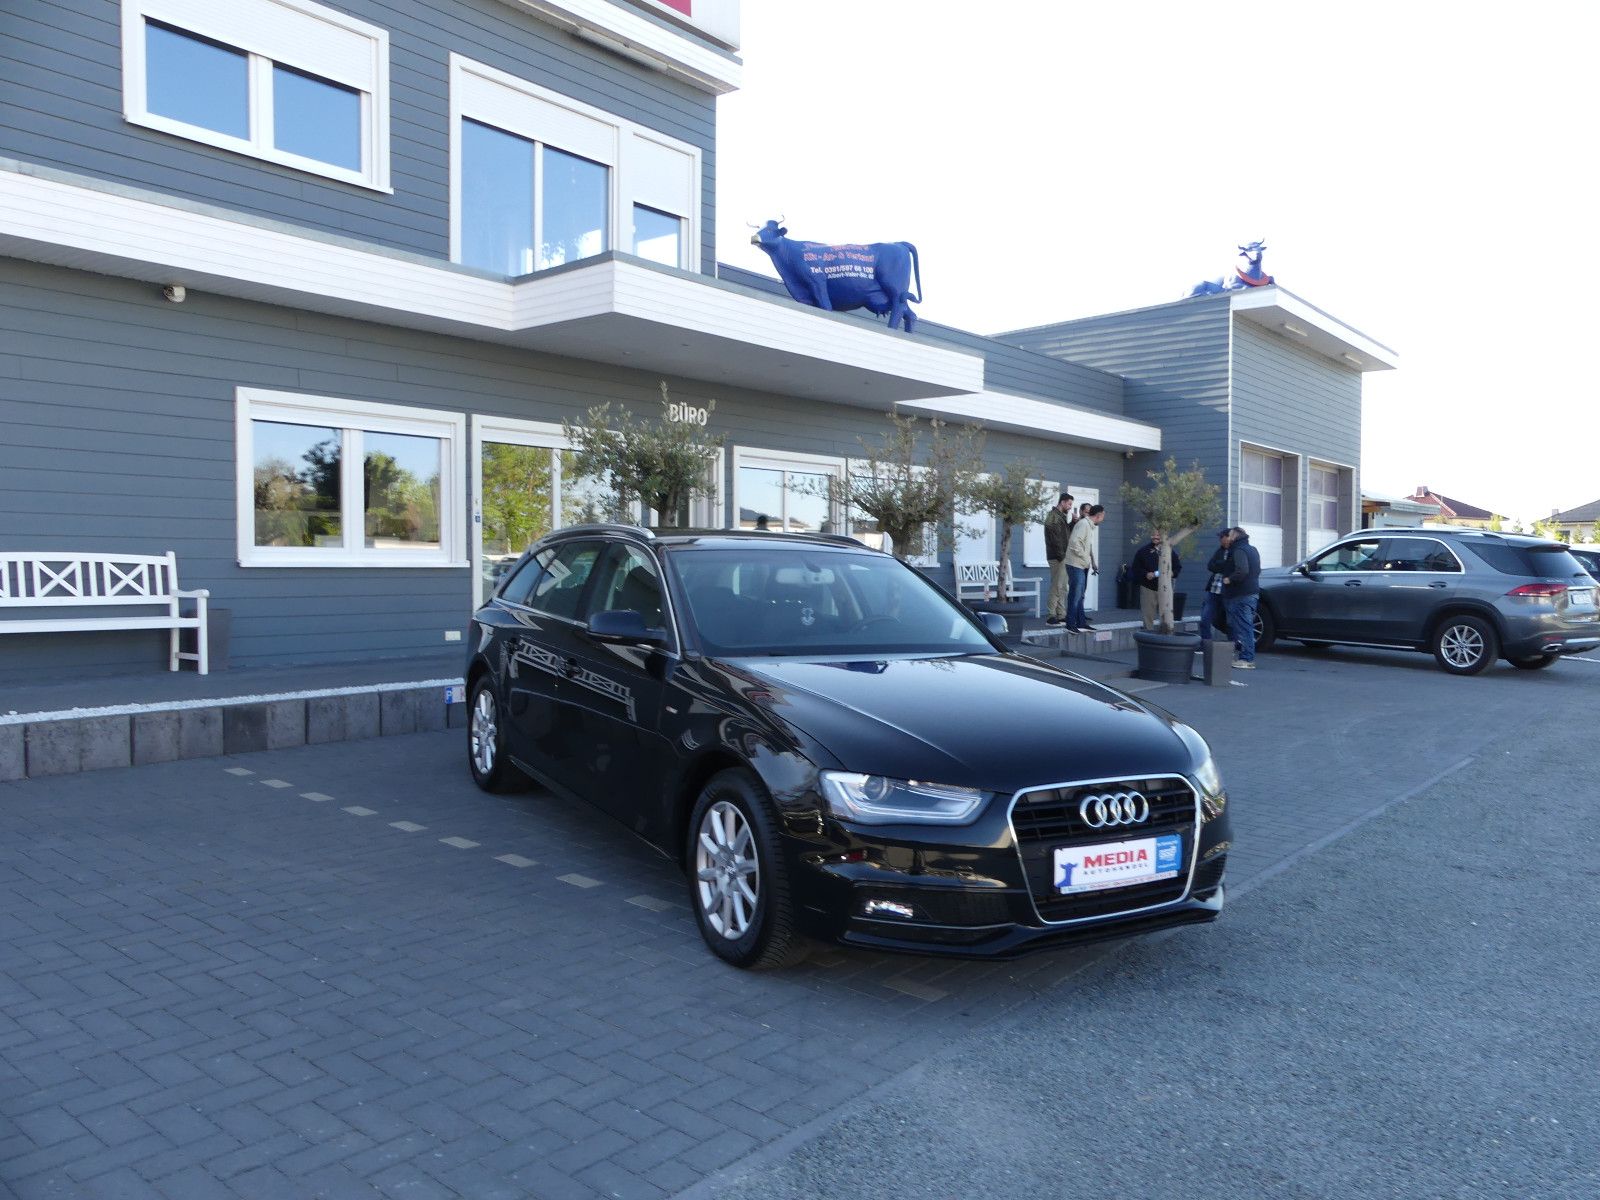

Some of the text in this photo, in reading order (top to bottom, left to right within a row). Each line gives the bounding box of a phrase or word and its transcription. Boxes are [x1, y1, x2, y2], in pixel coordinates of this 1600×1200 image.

[810, 266, 823, 274] Tel.
[669, 401, 708, 426] BÜRO
[1084, 849, 1148, 869] MEDIA
